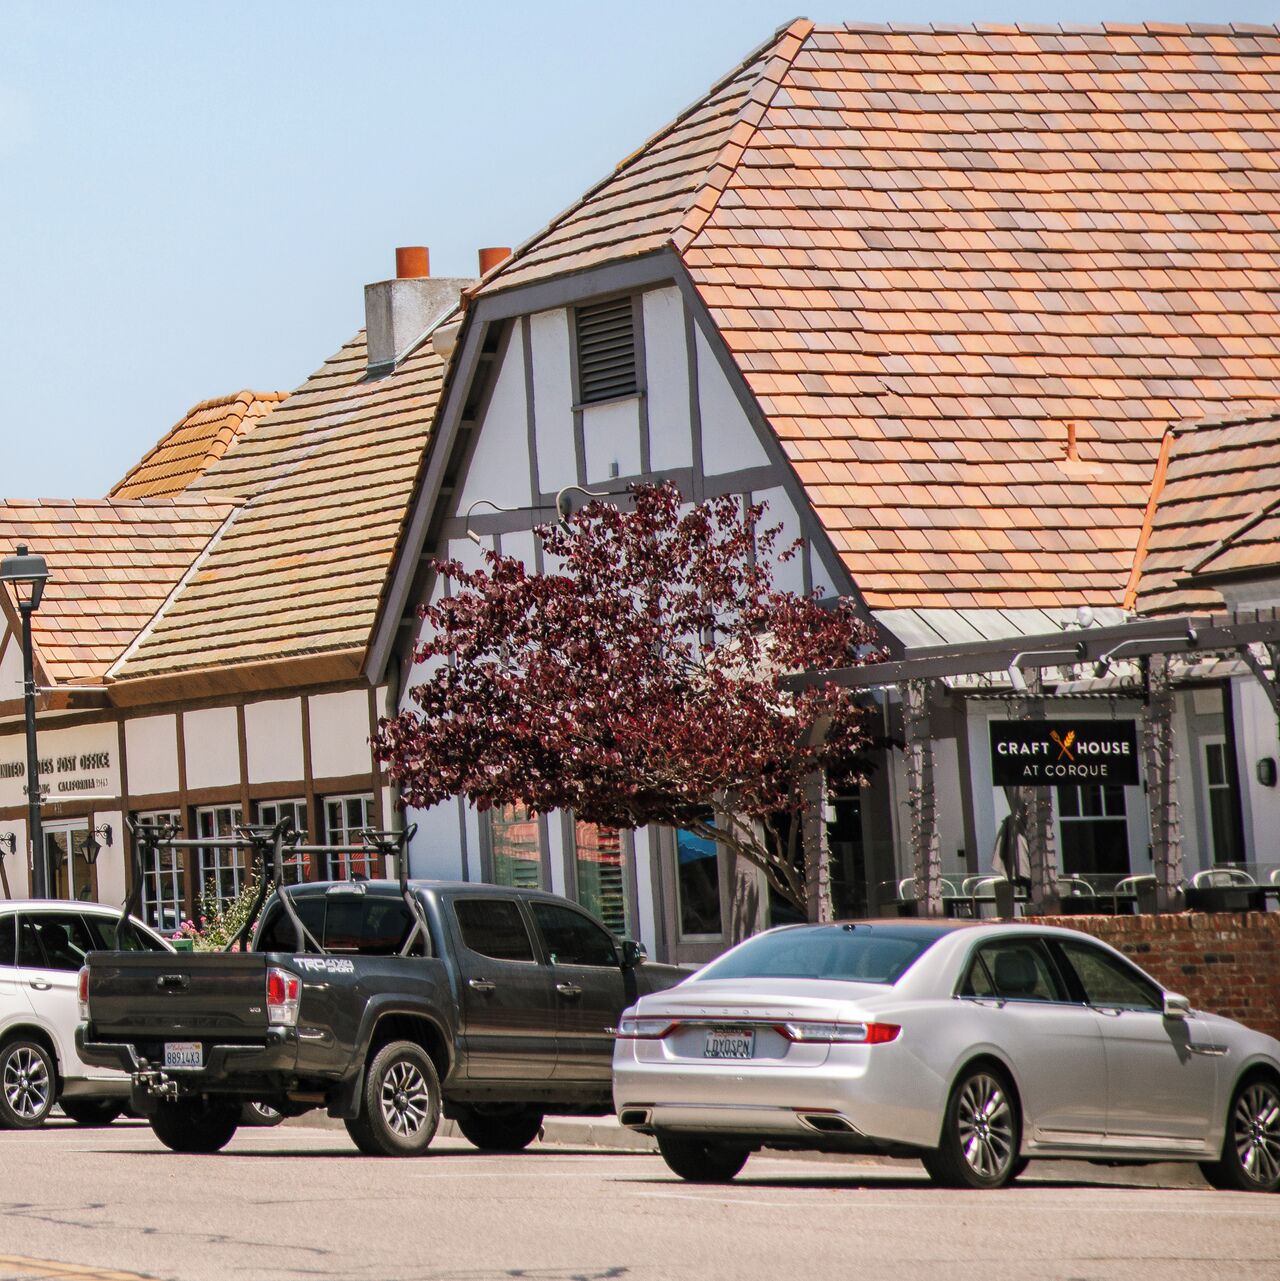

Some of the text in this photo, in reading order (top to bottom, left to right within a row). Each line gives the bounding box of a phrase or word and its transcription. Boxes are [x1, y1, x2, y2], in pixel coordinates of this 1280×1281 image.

[997, 742, 1130, 754] CRAFT HOUSE
[57, 756, 77, 773] POST
[80, 752, 110, 770] OFFICE
[1023, 764, 1109, 778] AT CORQUE
[58, 778, 95, 792] CALIFORNIA
[293, 958, 326, 971] TRD
[167, 1051, 200, 1065] 88914X3
